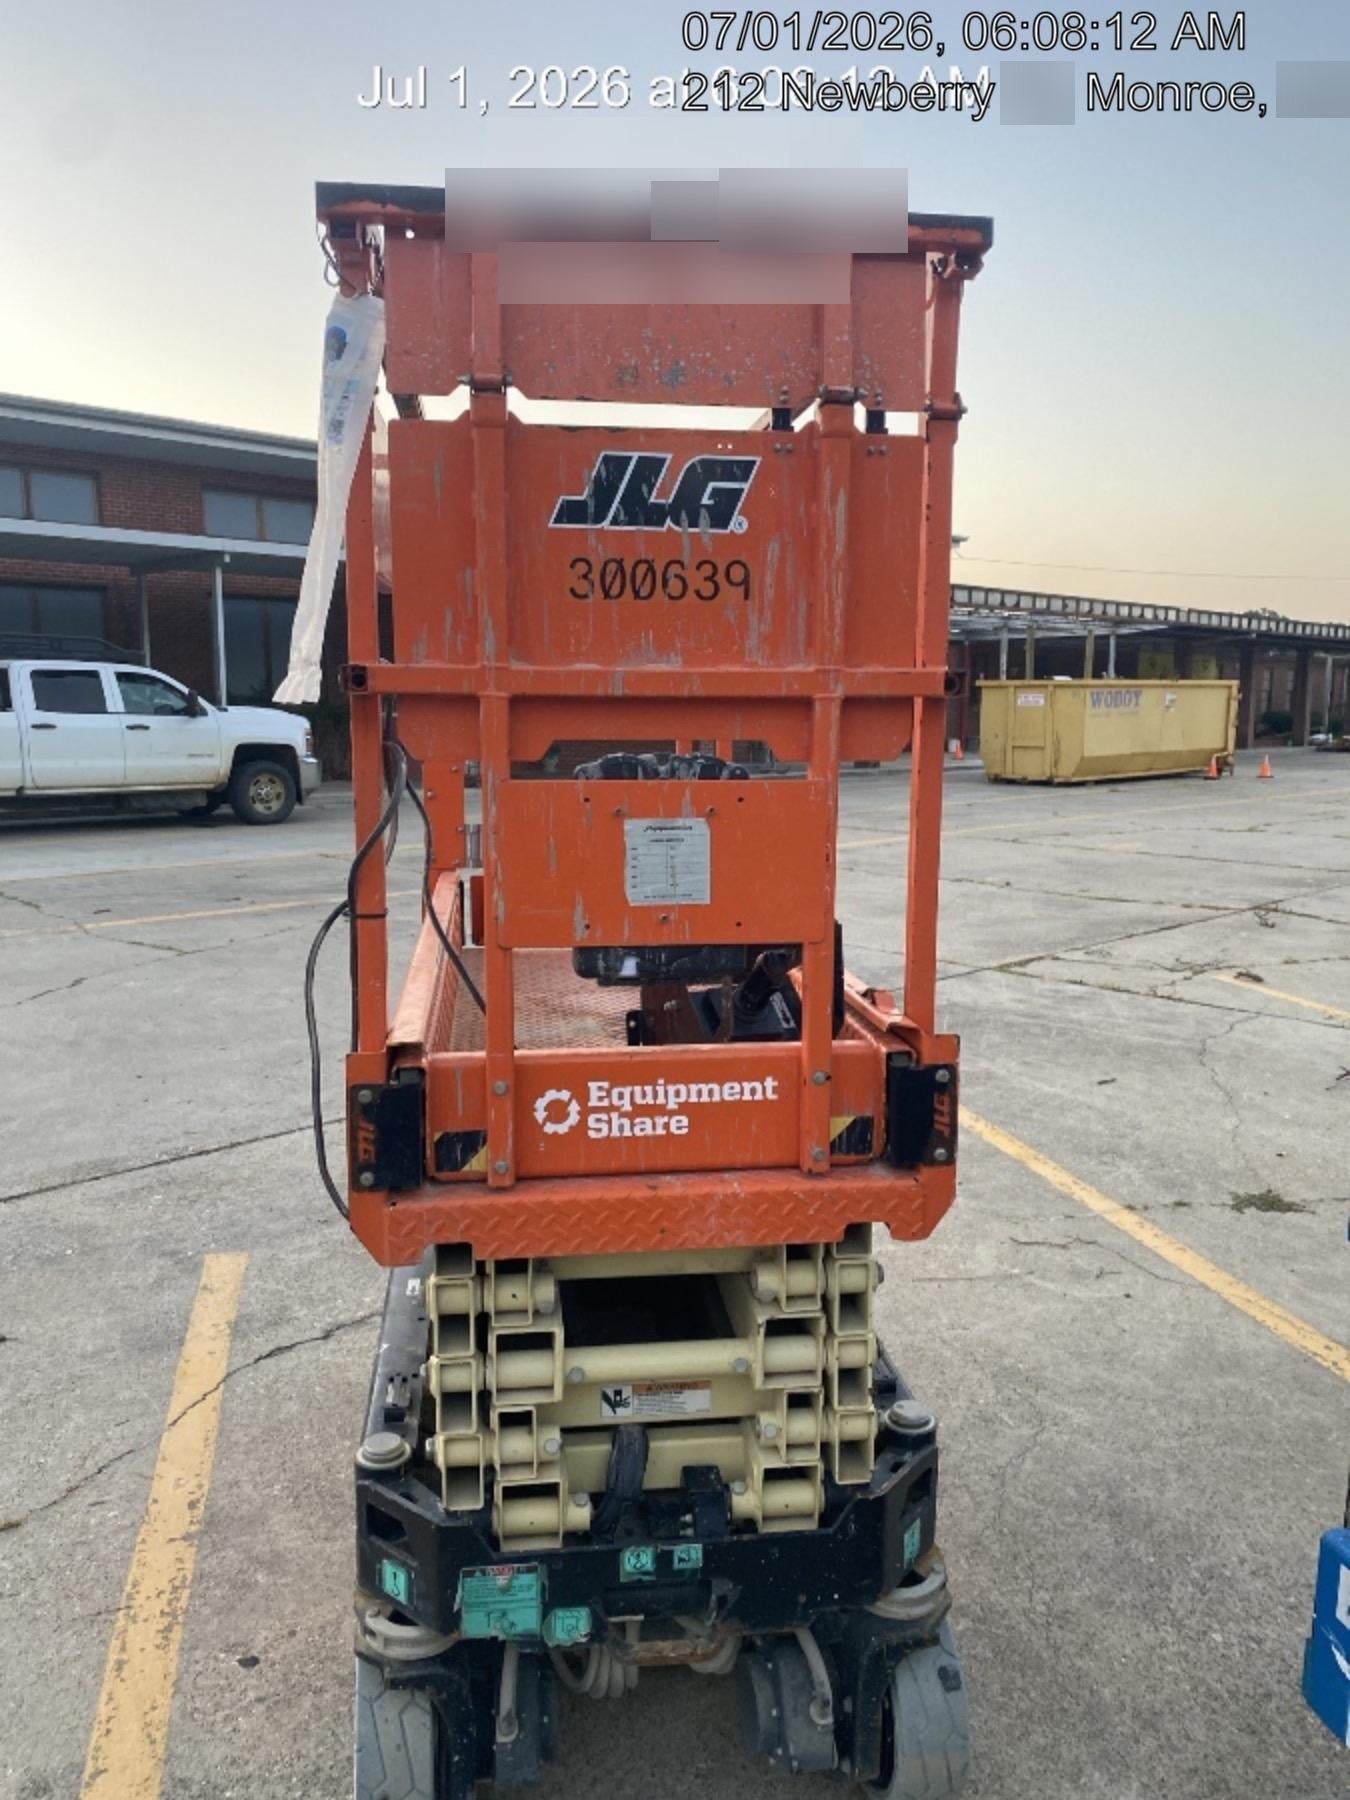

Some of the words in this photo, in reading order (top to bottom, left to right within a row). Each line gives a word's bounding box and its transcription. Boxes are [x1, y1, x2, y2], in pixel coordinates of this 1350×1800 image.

[548, 450, 762, 533] JLG
[568, 557, 751, 602] 300639
[587, 1076, 779, 1112] Equipment
[587, 1112, 690, 1139] Share
